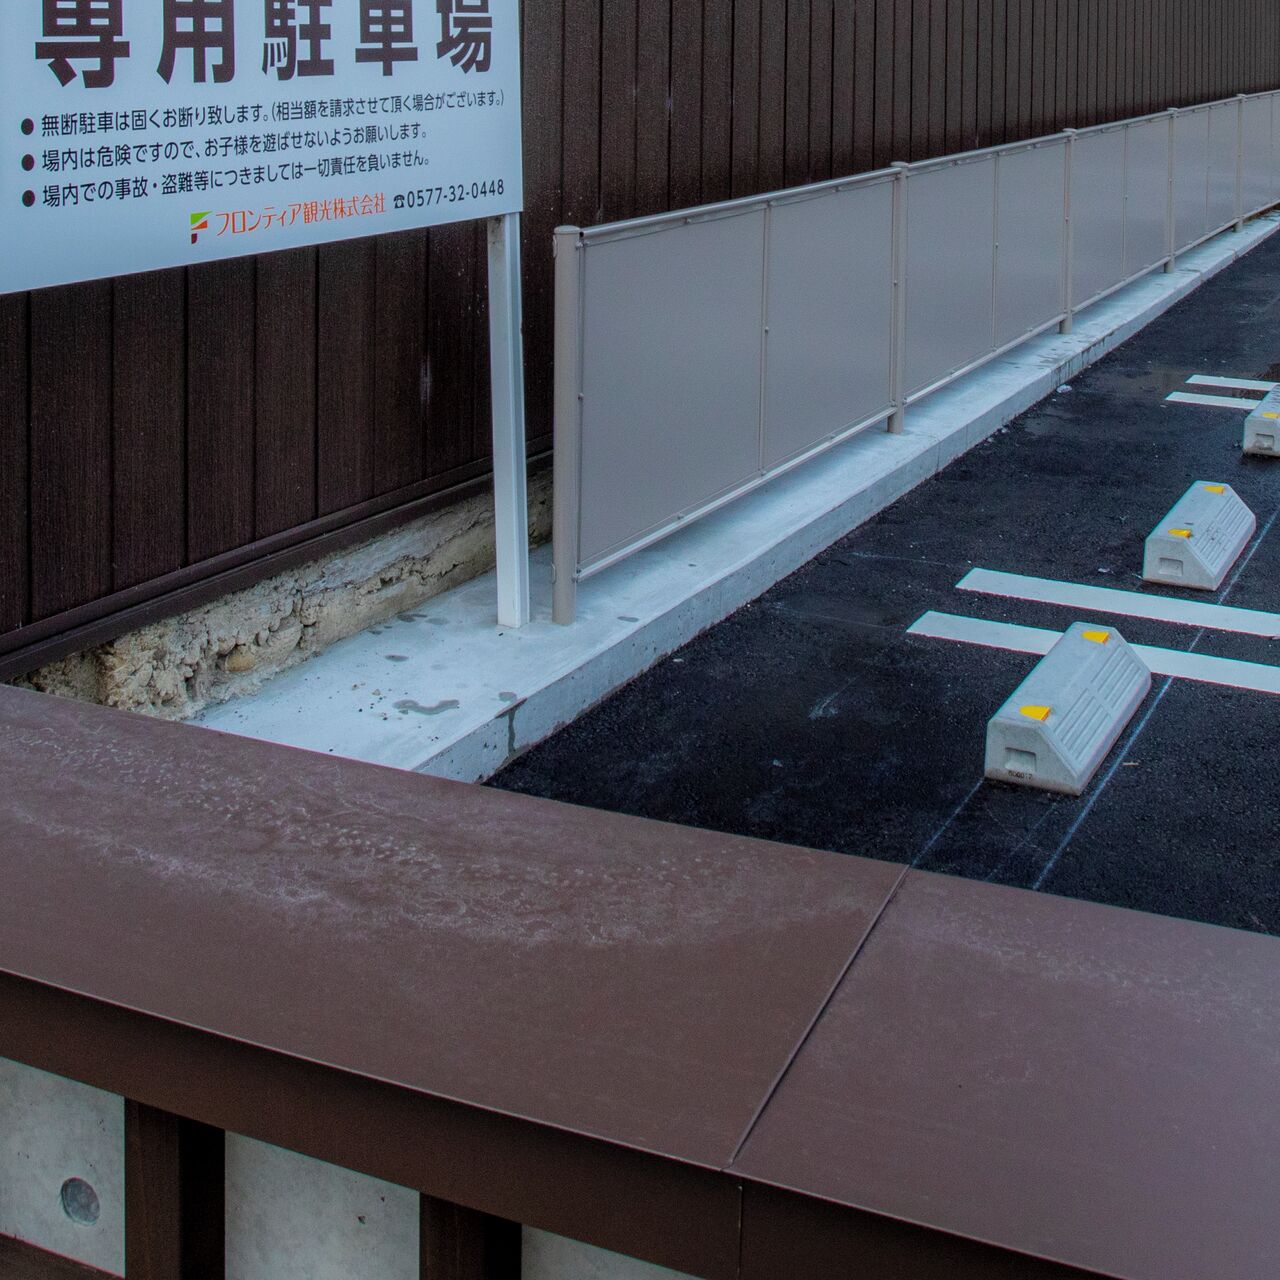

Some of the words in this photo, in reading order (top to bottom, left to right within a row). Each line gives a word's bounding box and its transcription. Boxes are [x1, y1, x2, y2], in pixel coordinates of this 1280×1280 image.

[215, 192, 386, 237] フロンティア観光株式会社
